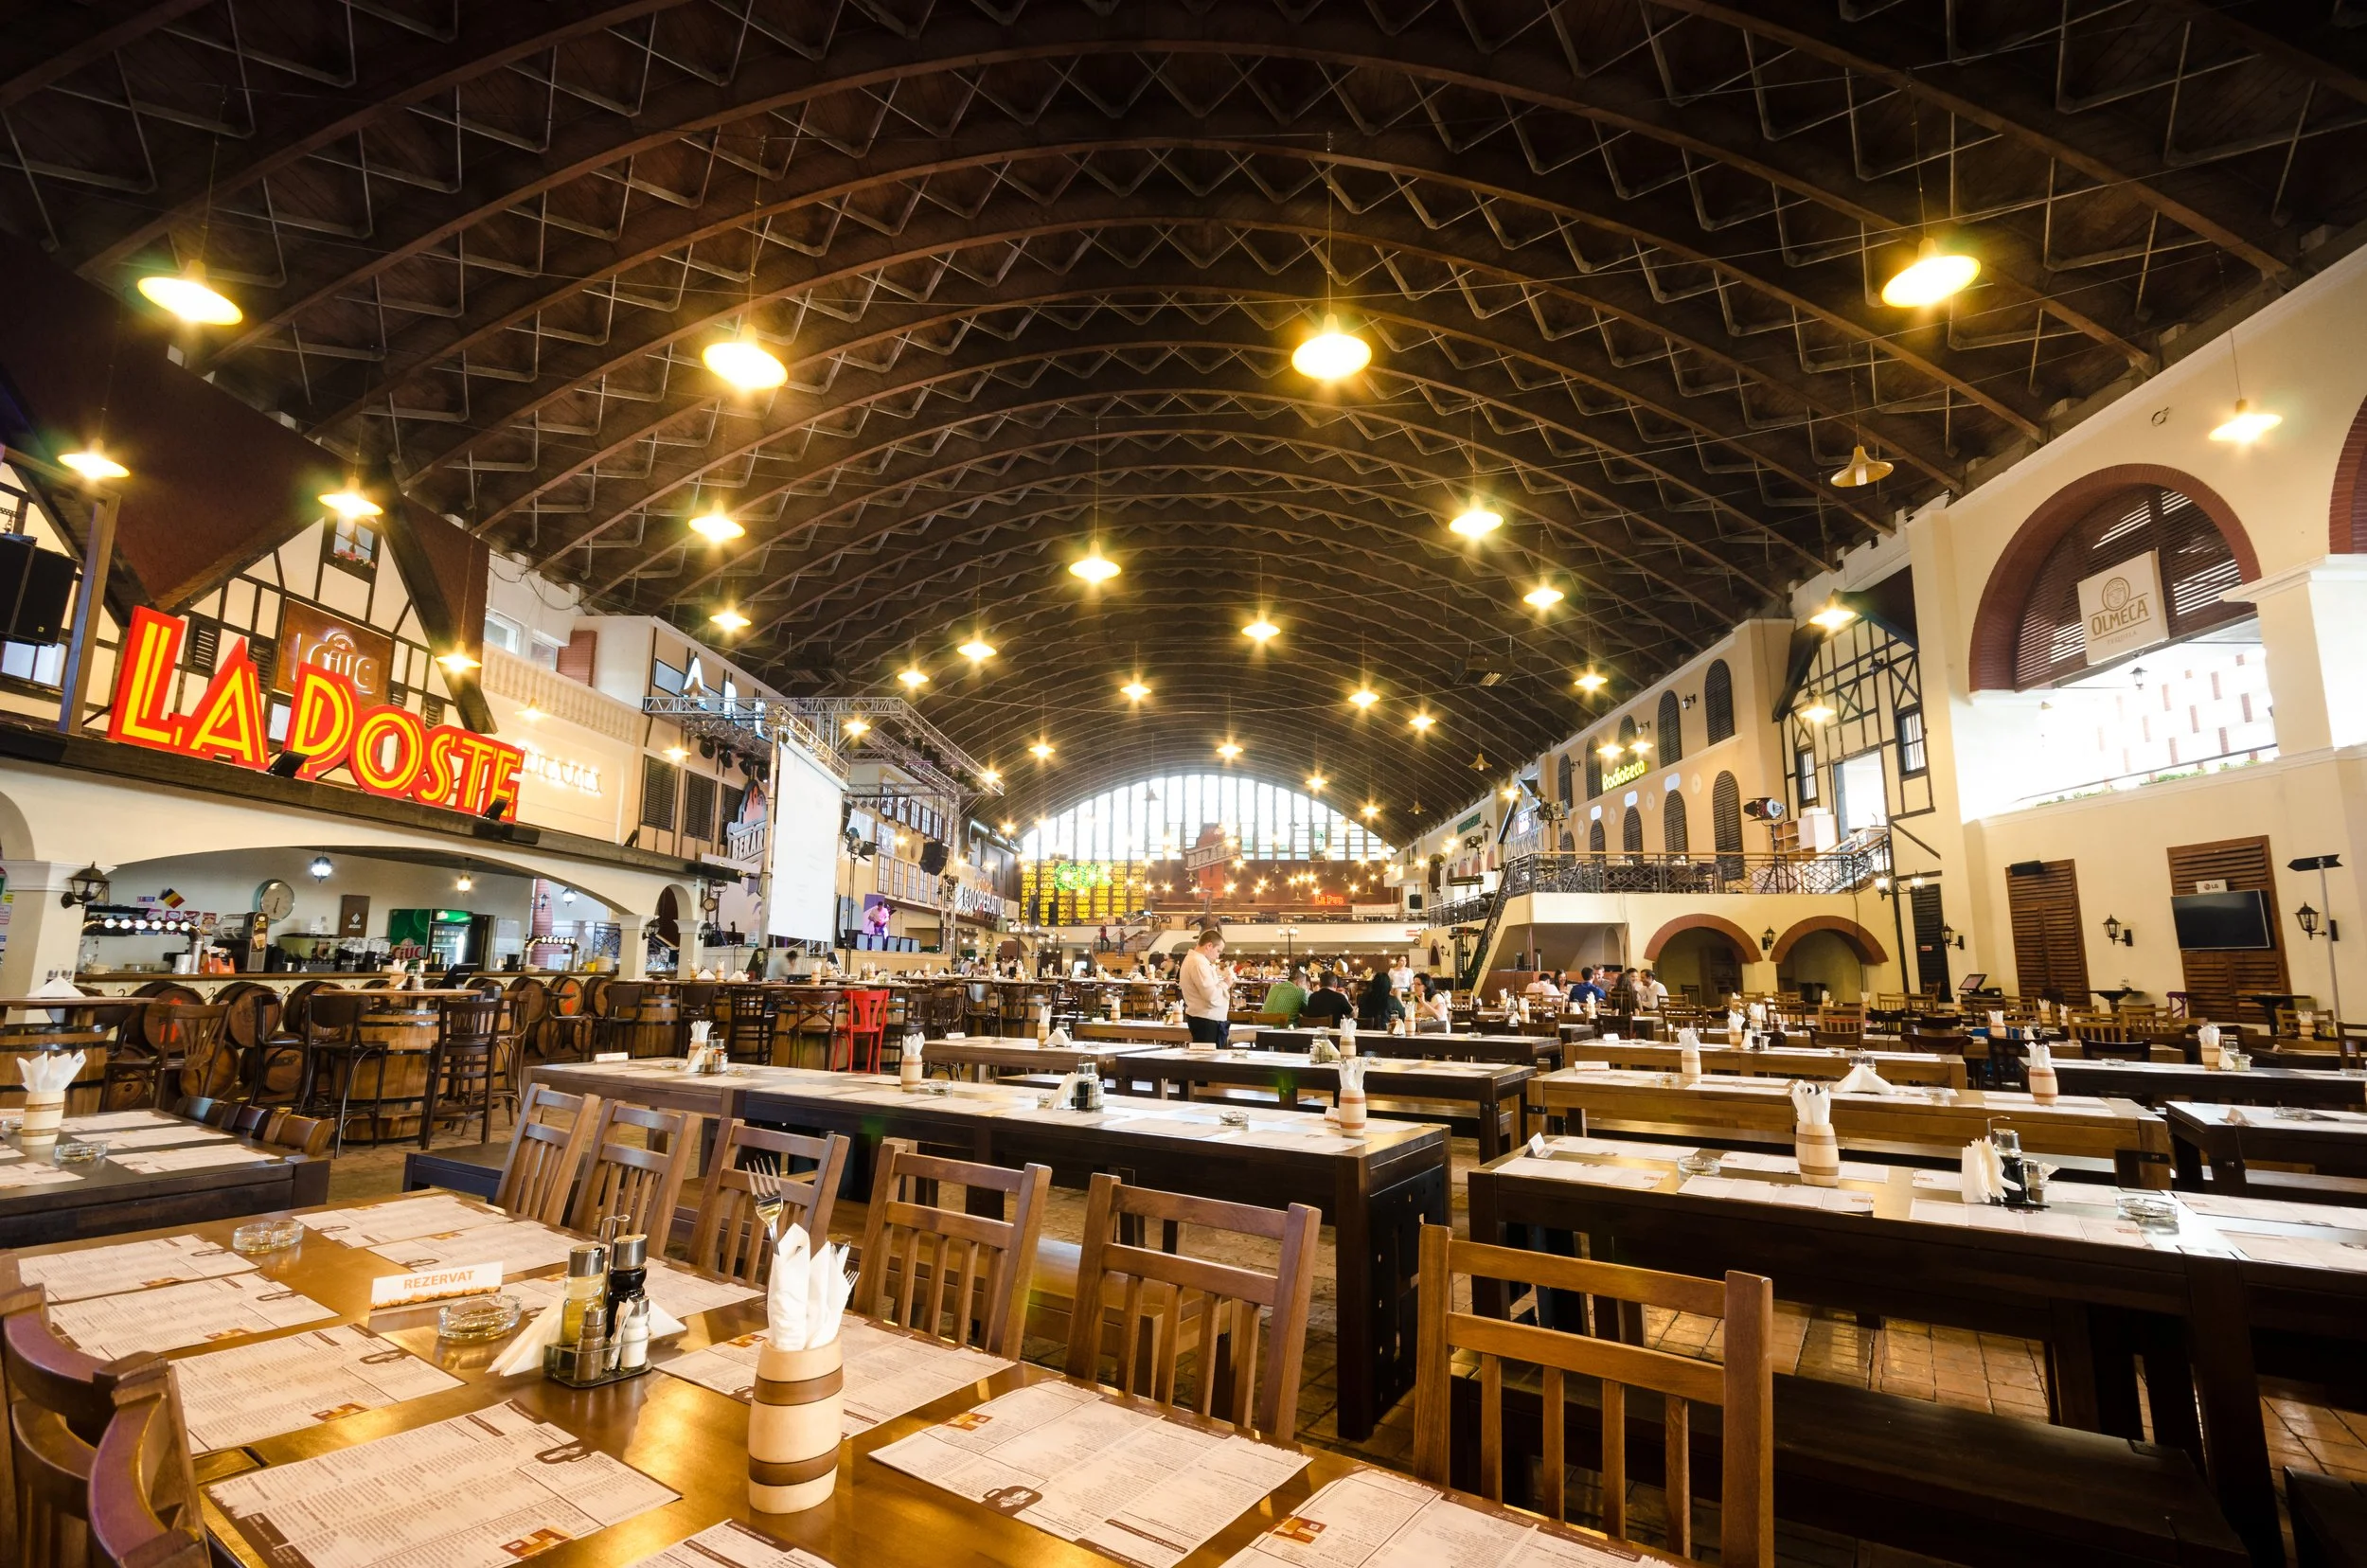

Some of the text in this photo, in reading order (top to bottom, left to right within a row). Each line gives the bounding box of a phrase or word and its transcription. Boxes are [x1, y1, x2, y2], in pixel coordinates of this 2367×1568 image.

[2091, 599, 2148, 635] OLMECA
[2107, 630, 2138, 645] TEQUILA
[108, 607, 526, 822] LA POSTE
[1602, 759, 1646, 792] Radioteca
[403, 1270, 475, 1290] REZERVAT
